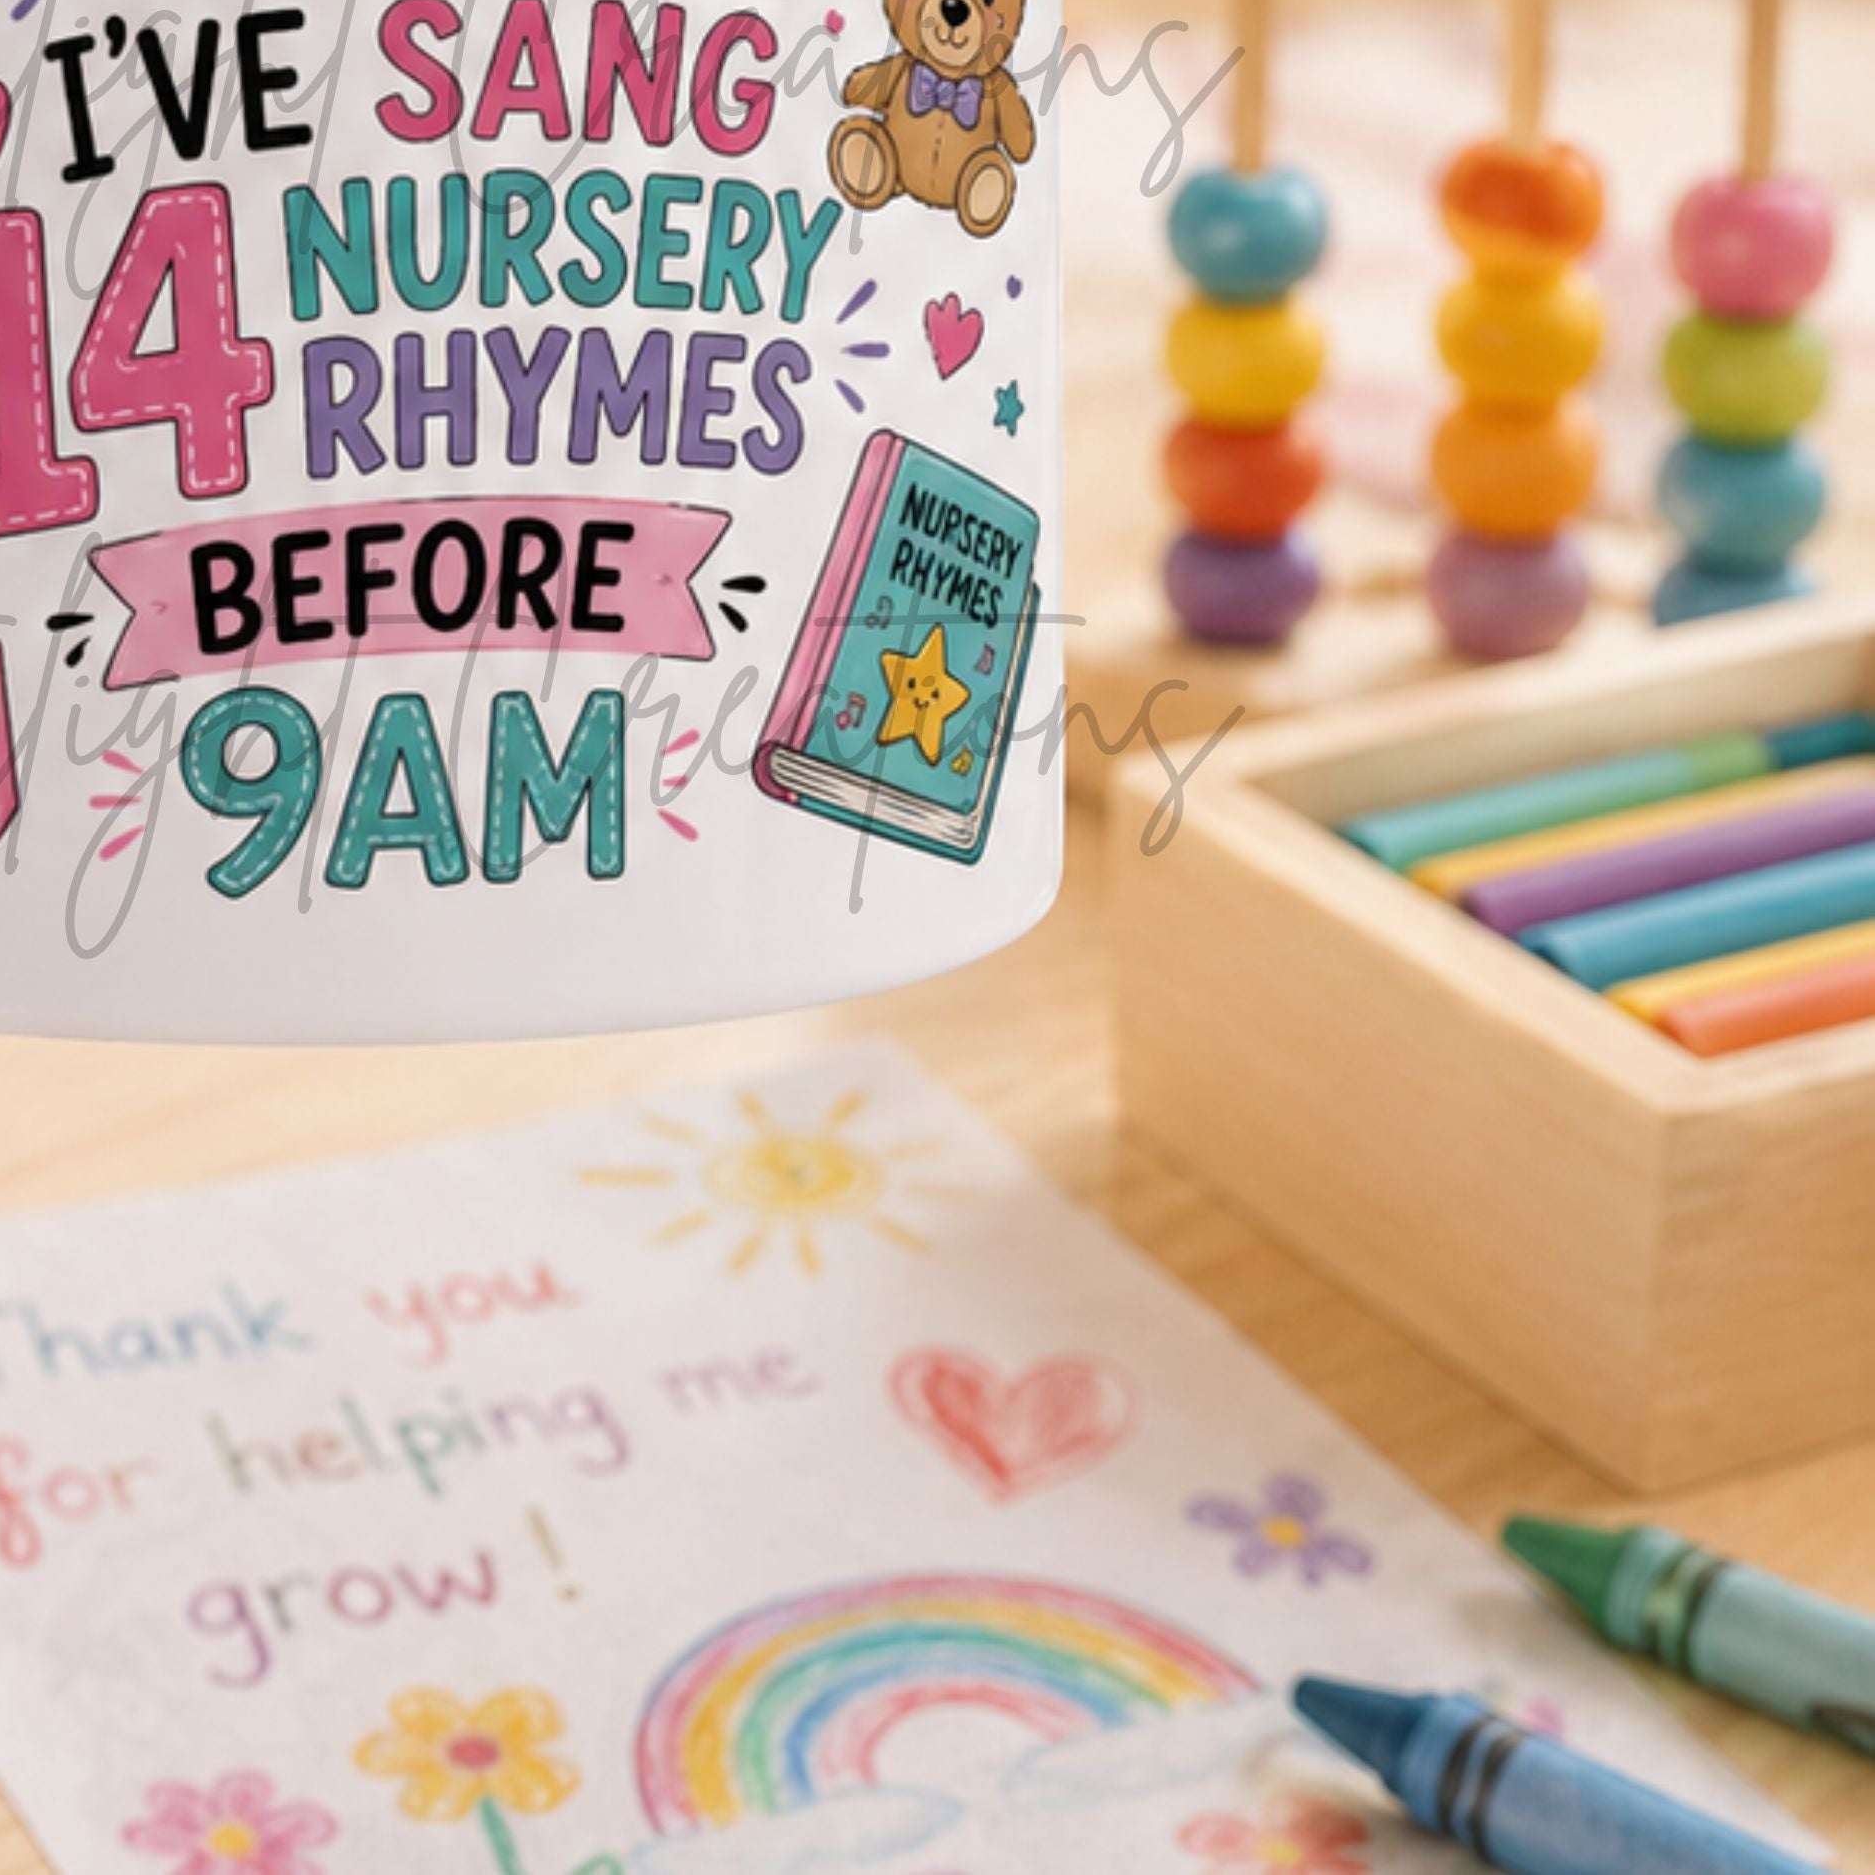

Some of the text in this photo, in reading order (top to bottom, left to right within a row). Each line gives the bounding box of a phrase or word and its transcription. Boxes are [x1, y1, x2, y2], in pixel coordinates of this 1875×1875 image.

[282, 167, 845, 323] NURSERY
[301, 325, 813, 480] RHYMES
[189, 516, 636, 657] BEFORE
[889, 536, 1004, 630] RHYMES
[177, 685, 627, 899] 9AM
[360, 1254, 589, 1368] you
[205, 1385, 633, 1503] helping
[655, 1342, 822, 1422] me
